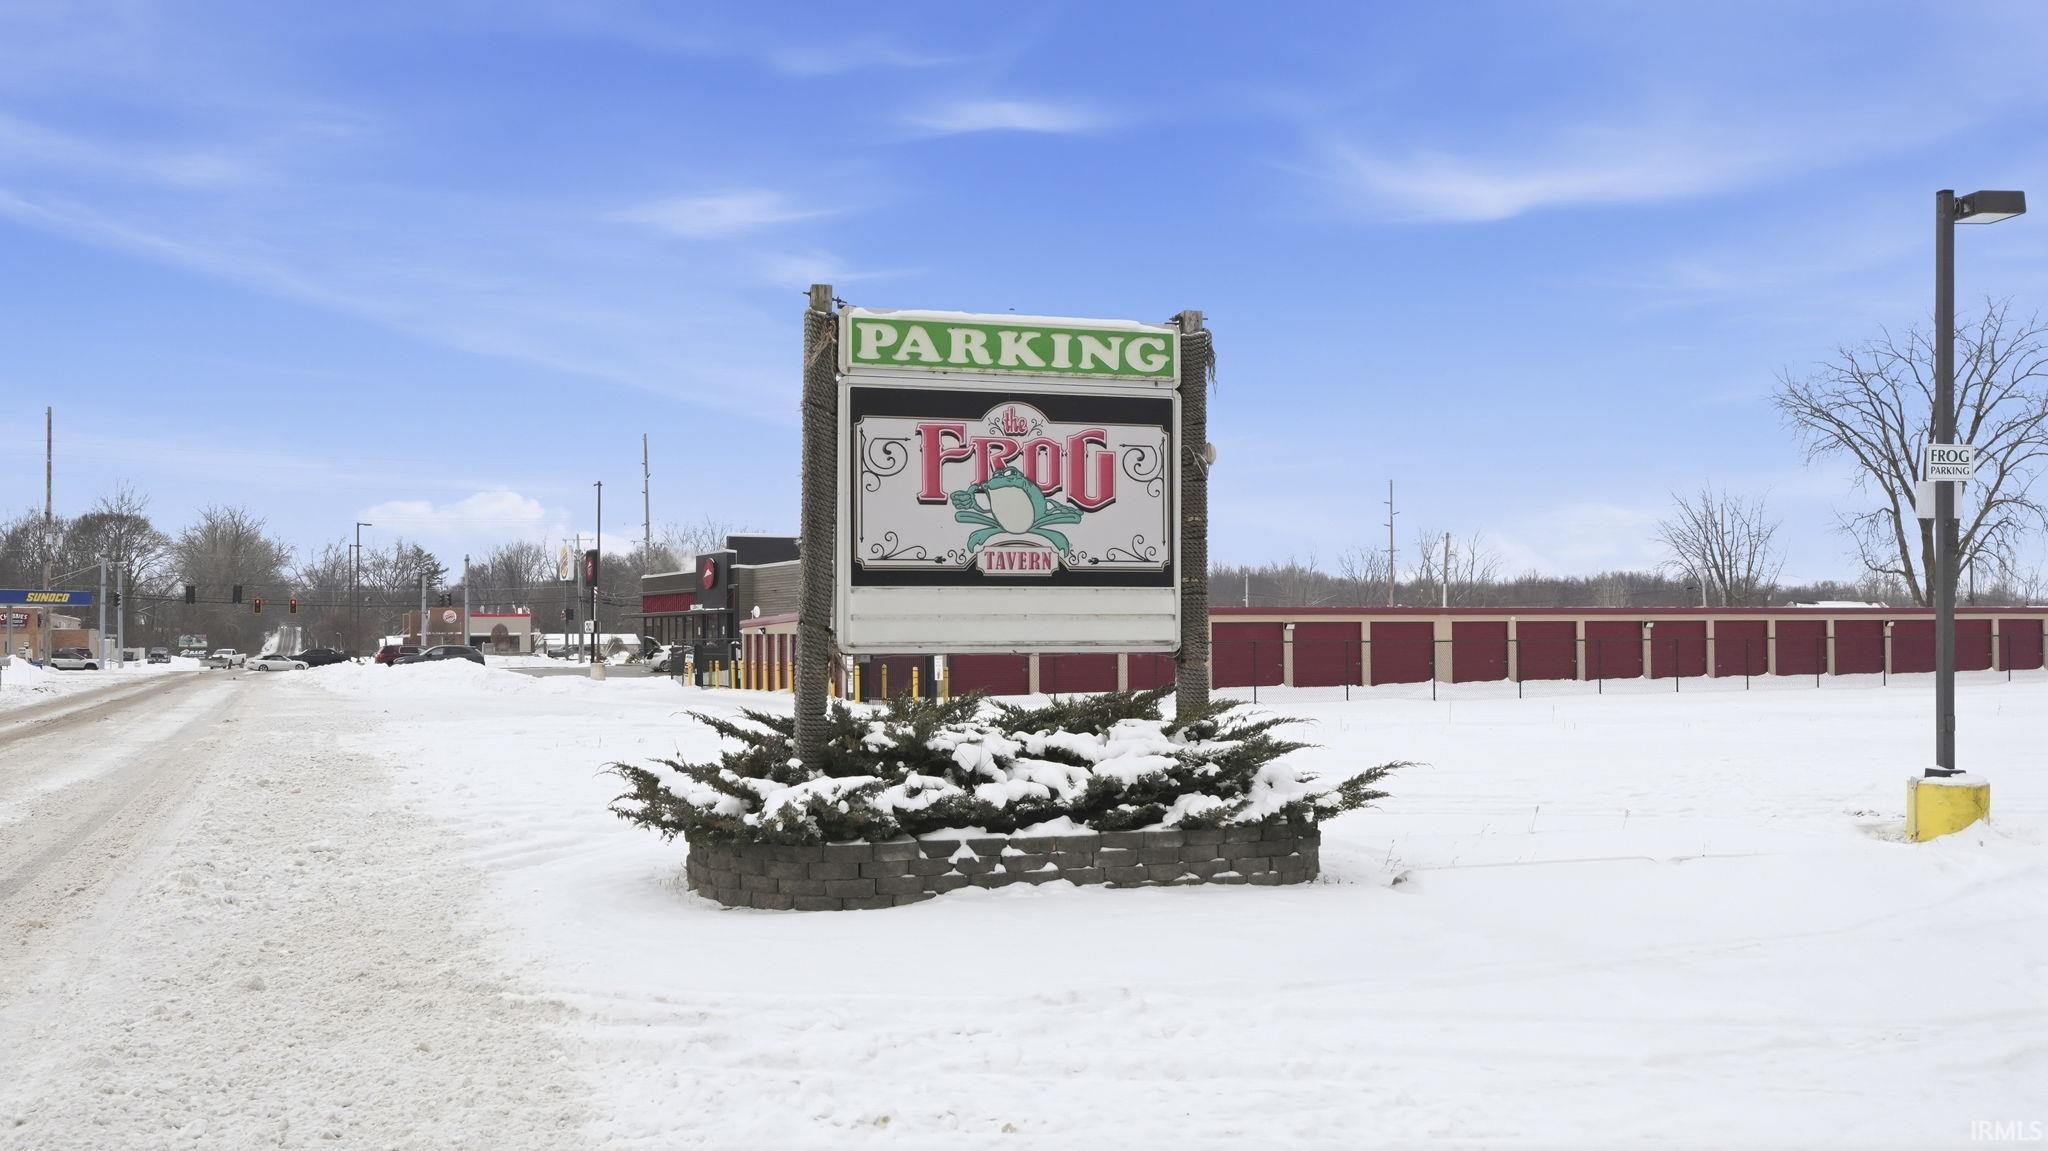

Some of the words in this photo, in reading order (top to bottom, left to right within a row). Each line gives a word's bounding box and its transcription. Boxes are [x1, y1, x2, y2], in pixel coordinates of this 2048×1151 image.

[856, 322, 1170, 373] PARKING
[1002, 406, 1028, 436] the
[1930, 449, 1969, 462] FROG
[916, 422, 1116, 512] FROG
[1930, 466, 1969, 475] PARKING
[984, 551, 1053, 572] TAVERN
[26, 592, 70, 603] SUNOCO
